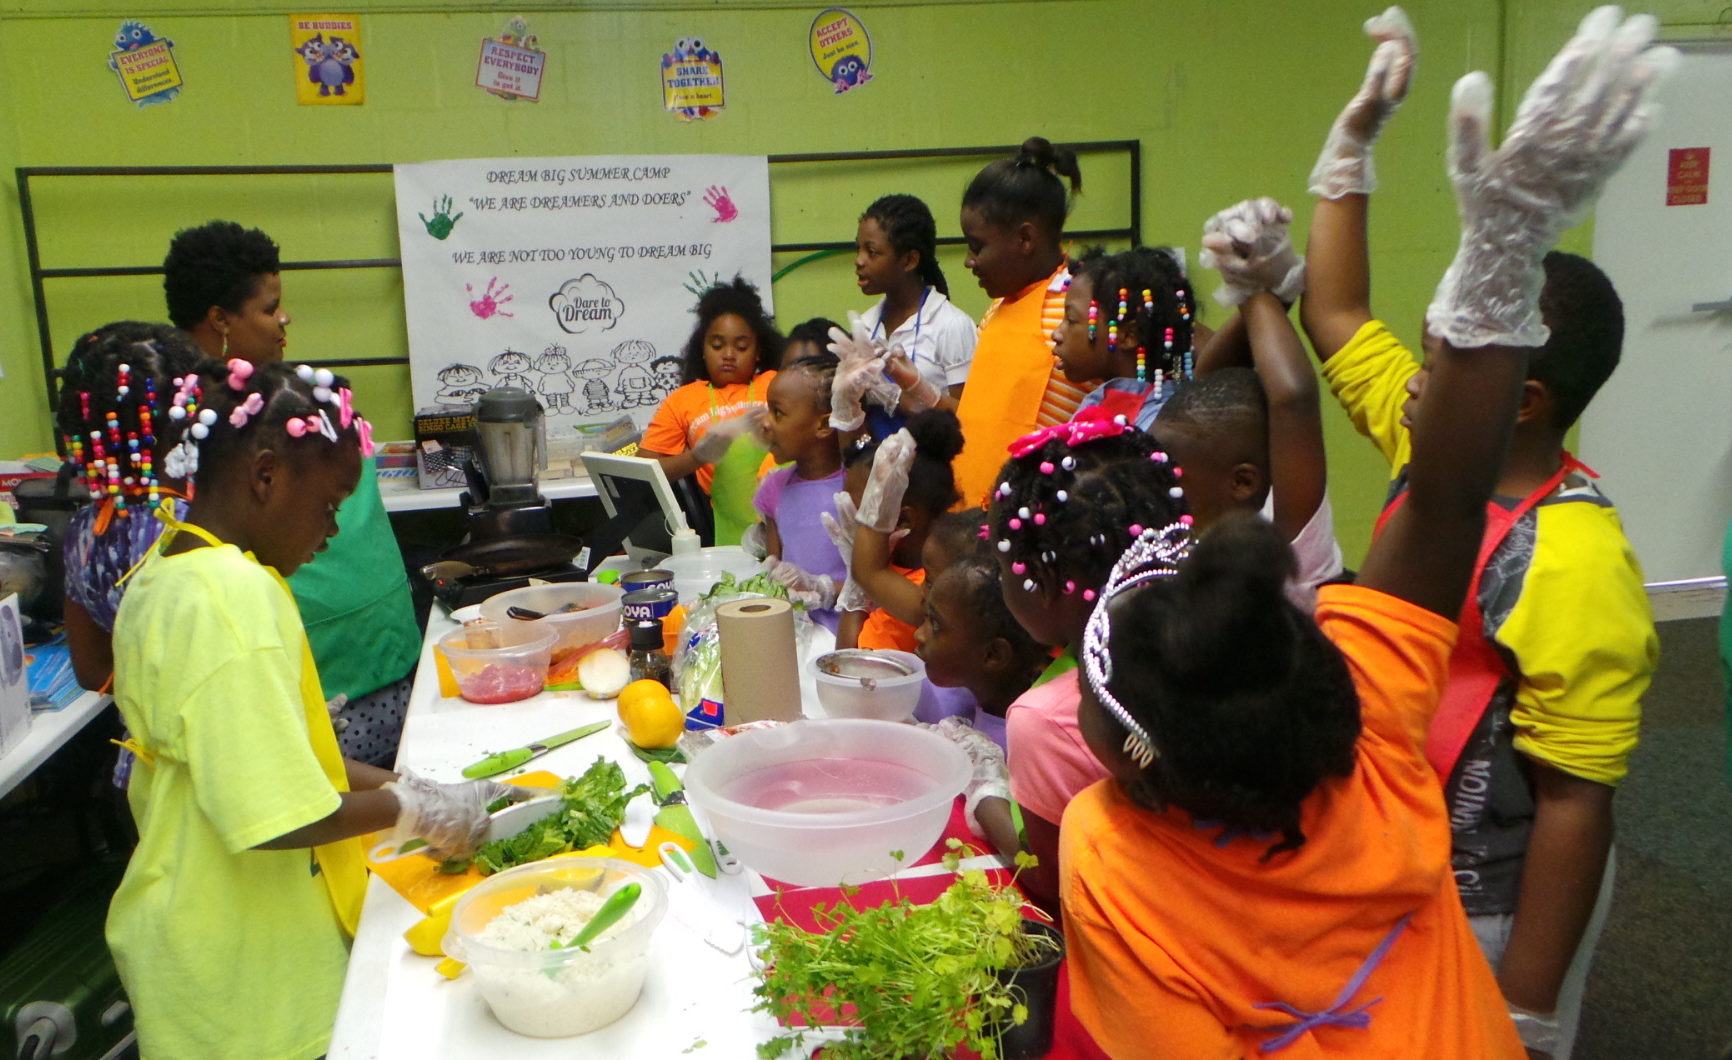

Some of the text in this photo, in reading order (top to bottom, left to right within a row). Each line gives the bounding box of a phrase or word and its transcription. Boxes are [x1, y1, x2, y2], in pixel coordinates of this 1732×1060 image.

[298, 21, 352, 29] BE BUDDIES
[816, 17, 848, 37] ACCEPT
[820, 27, 854, 48] OTHERS
[120, 45, 166, 64] EVERYONE
[491, 46, 536, 64] RESPECT
[126, 56, 169, 74] IS SPECIAL
[484, 56, 539, 75] EVERYBODY
[676, 66, 709, 76] SHARE
[667, 77, 719, 88] TOGETHER
[486, 167, 671, 185] DREAM BIG SUMMER CAMP
[498, 197, 527, 211] ARE
[530, 195, 606, 210] DREAMERS
[608, 193, 639, 208] AND
[452, 243, 712, 265] WE ARE NOT TOO YOUNG TO DREAM BIG
[574, 296, 611, 309] Dare to
[562, 304, 612, 322] Dream
[452, 415, 478, 425] META
[624, 605, 651, 617] OYA
